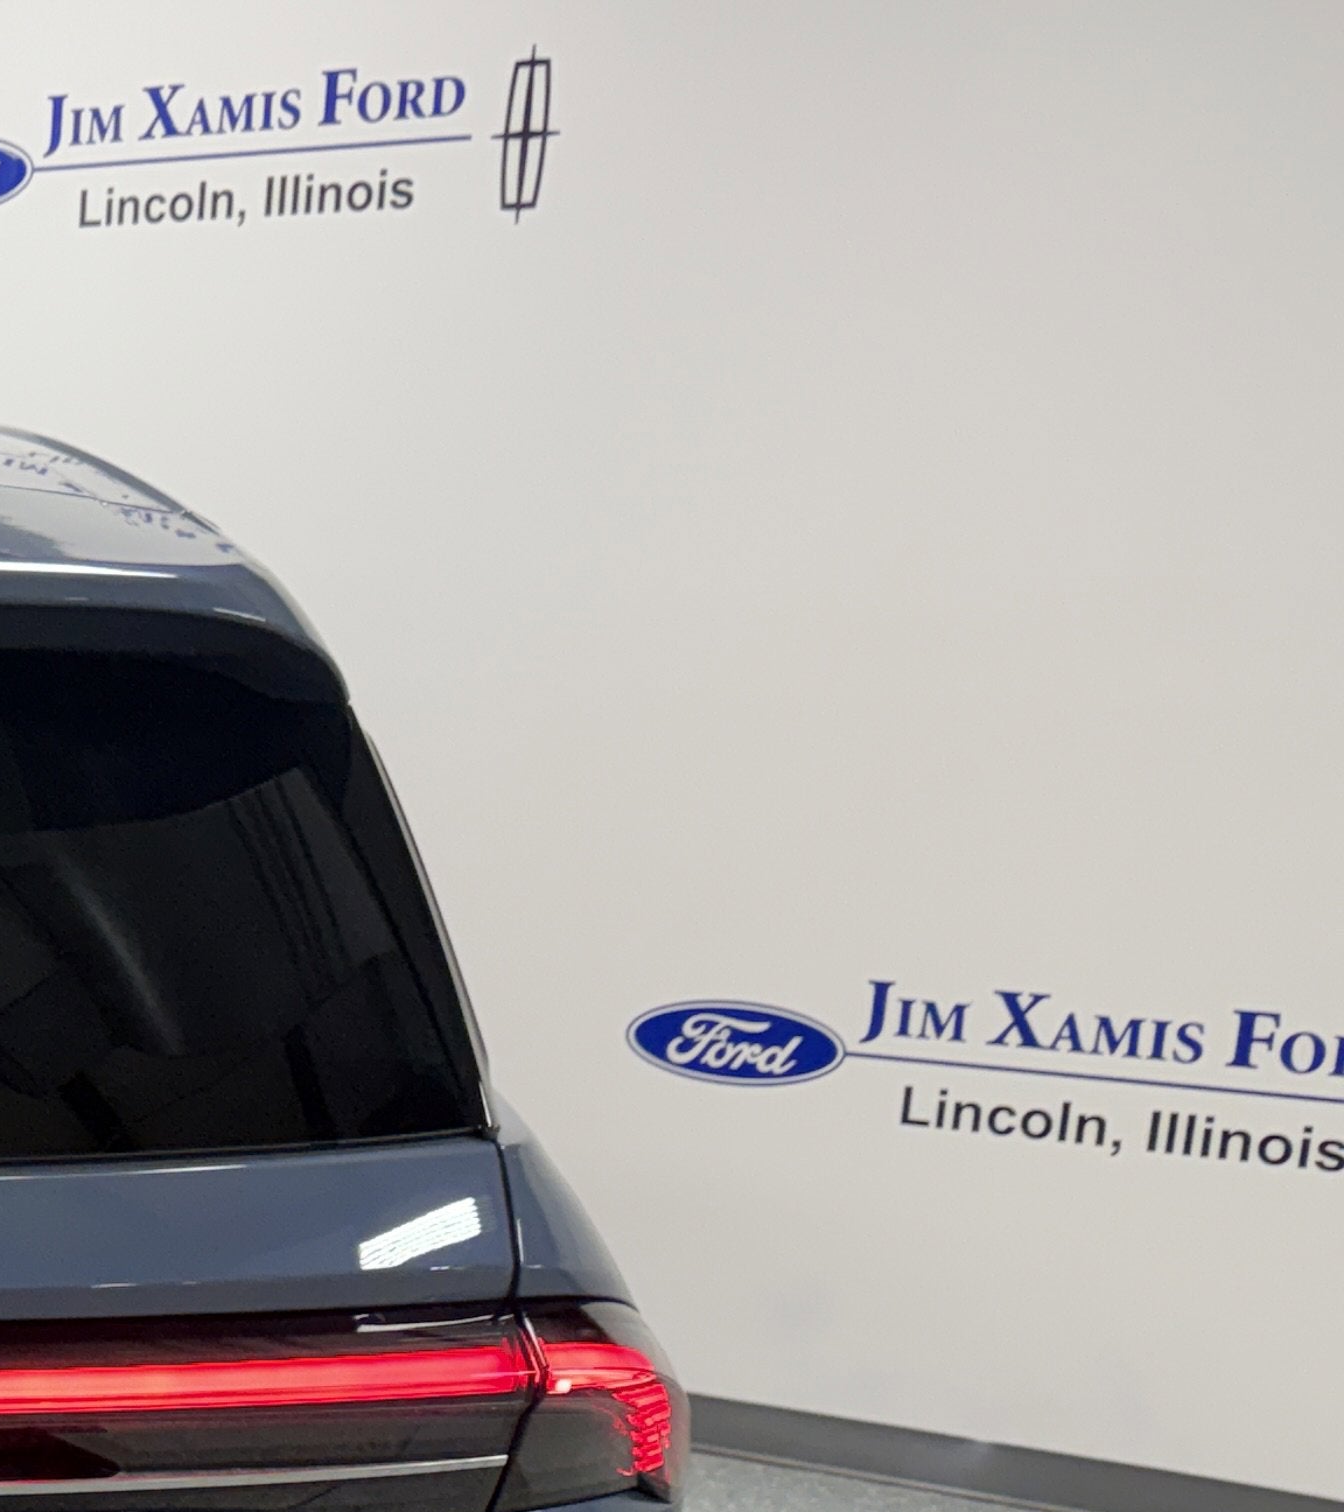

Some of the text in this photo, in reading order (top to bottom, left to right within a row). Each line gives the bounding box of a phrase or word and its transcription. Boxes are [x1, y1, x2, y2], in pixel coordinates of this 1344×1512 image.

[43, 68, 466, 158] JIM XAMIS FORD
[78, 168, 414, 229] Lincoln, Illinois
[664, 1011, 805, 1078] Ford
[858, 980, 970, 1044] JIM
[987, 990, 1205, 1065] XAMIS
[900, 1086, 1344, 1173] Lincoln, Illinois
